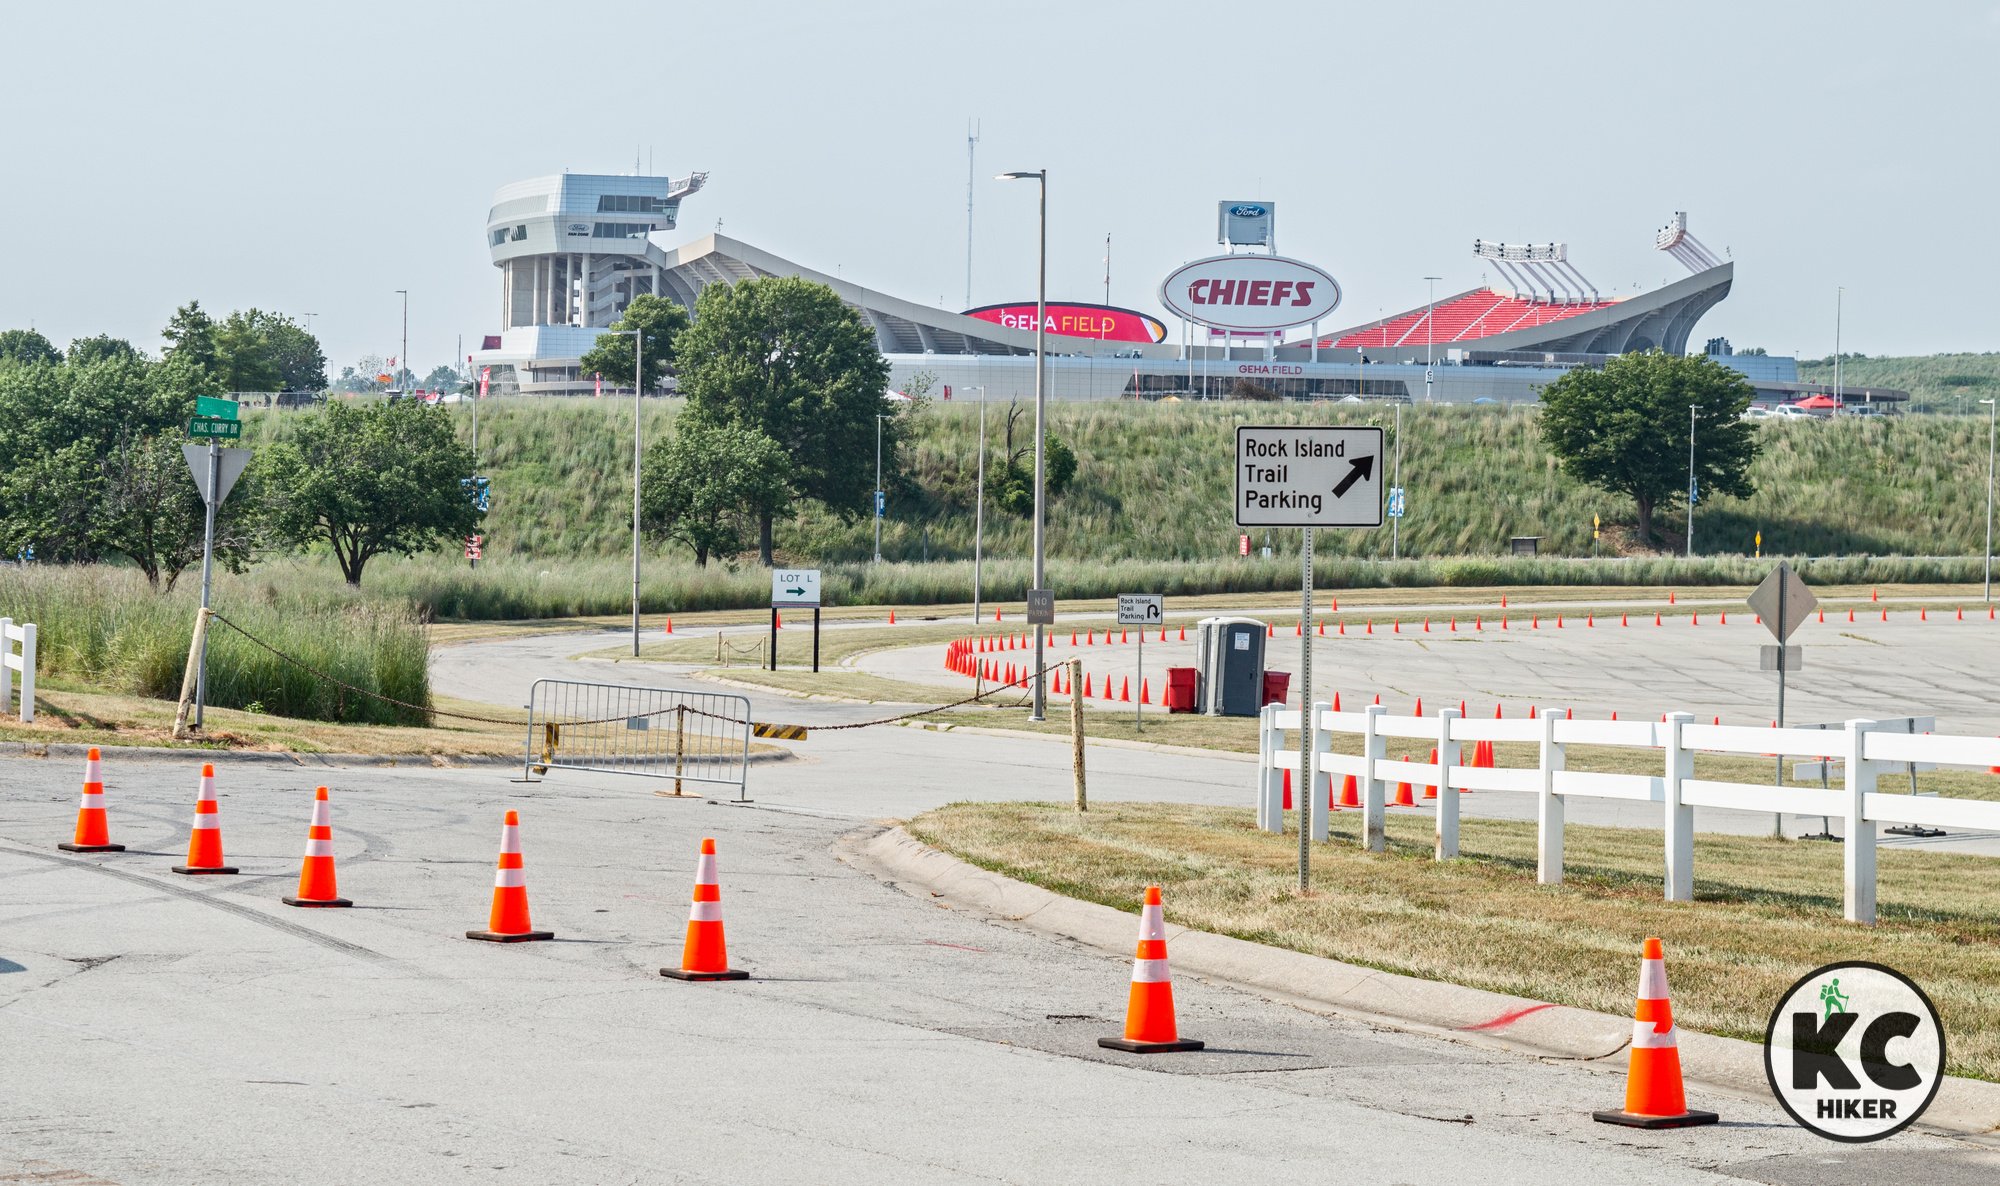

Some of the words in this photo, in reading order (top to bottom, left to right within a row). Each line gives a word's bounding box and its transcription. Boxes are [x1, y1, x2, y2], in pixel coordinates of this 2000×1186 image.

[1236, 205, 1260, 216] Ford
[1188, 279, 1315, 307] CHIEFS
[1003, 314, 1057, 331] GEHA
[1062, 316, 1115, 332] FIELD
[1238, 364, 1270, 374] GEHA
[1272, 365, 1303, 375] FIELD
[211, 422, 229, 434] CURRY
[230, 423, 238, 434] DR
[1246, 438, 1288, 457] Rock
[1295, 439, 1345, 458] Island
[1245, 464, 1288, 483] Trail
[1245, 490, 1322, 515] Parking
[780, 574, 800, 583] LOT
[807, 574, 813, 583] L
[1034, 597, 1047, 606] NO
[1120, 597, 1134, 605] Rock
[1120, 612, 1145, 621] Parking
